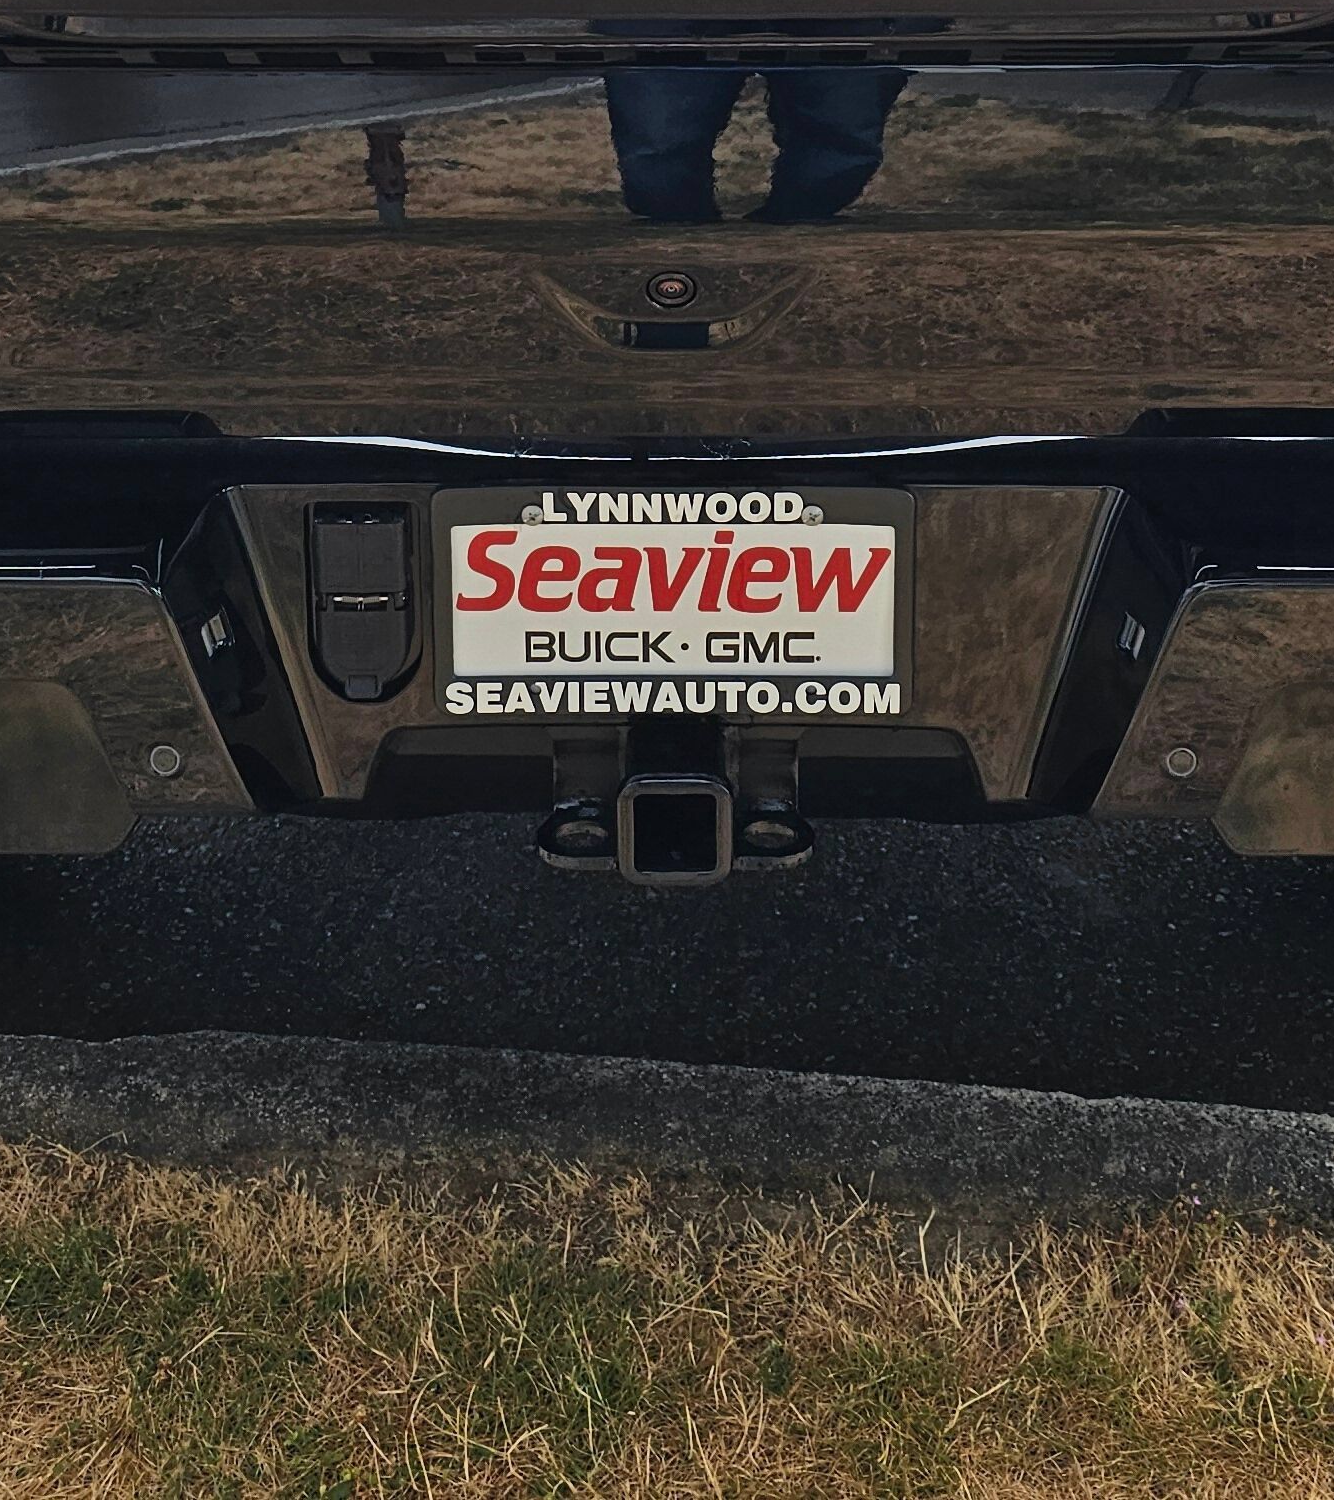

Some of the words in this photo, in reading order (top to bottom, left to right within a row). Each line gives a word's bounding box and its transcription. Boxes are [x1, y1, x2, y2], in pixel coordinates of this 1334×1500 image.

[542, 491, 804, 524] LYNNWOOD
[455, 529, 892, 614] Seaview
[524, 631, 676, 664] BUICK
[444, 681, 902, 715] SEAVIEWAUTO.COM
